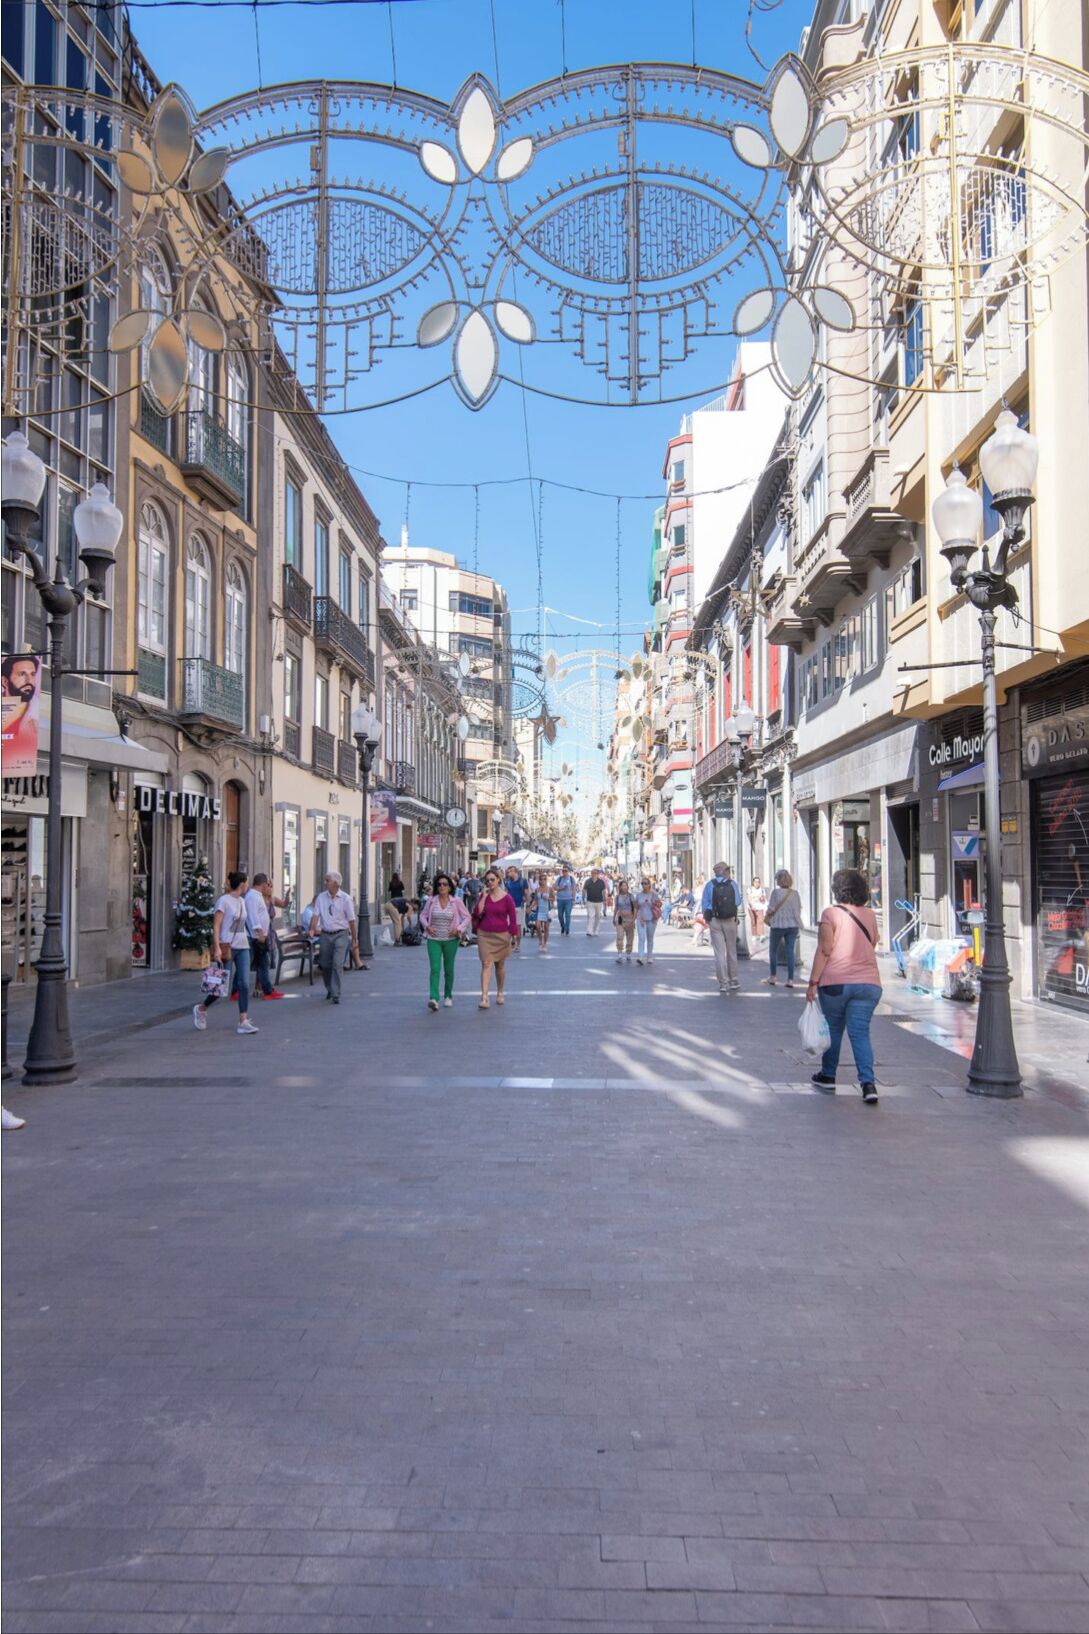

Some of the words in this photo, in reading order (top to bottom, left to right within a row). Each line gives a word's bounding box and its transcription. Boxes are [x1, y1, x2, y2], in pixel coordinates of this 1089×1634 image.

[929, 742, 951, 766] Calle
[953, 735, 984, 763] Mayor
[140, 786, 221, 820] DECIMAS
